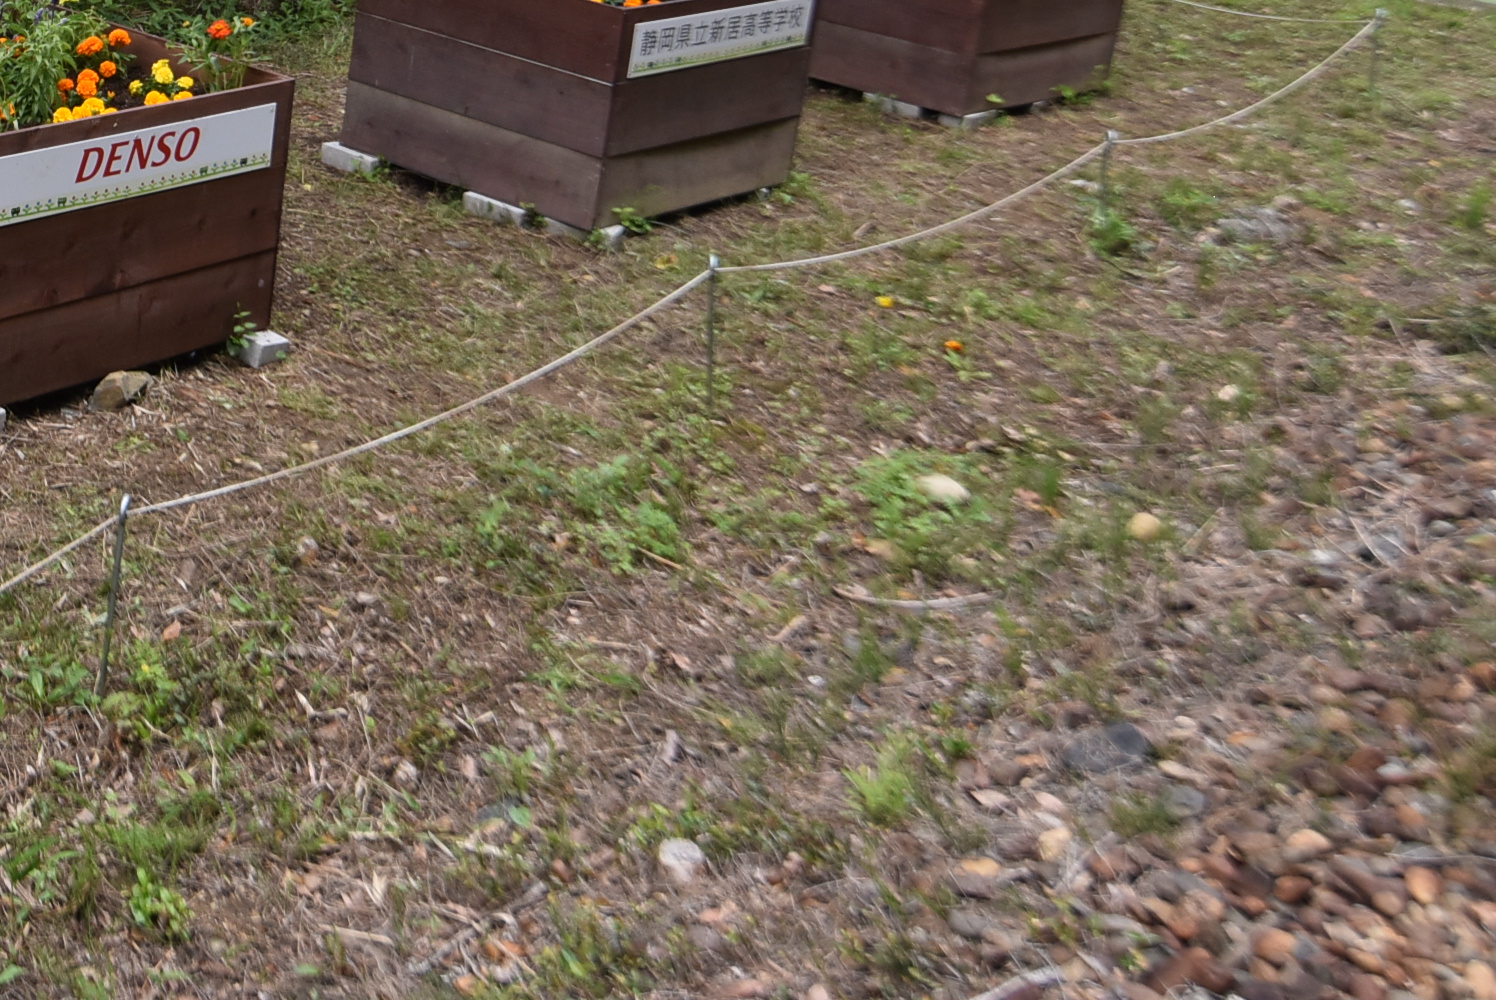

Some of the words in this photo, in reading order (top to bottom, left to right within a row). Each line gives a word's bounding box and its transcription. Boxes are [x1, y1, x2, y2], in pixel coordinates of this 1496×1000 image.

[640, 5, 804, 56] 静岡県立新居高等学校
[75, 126, 201, 183] DENSO
